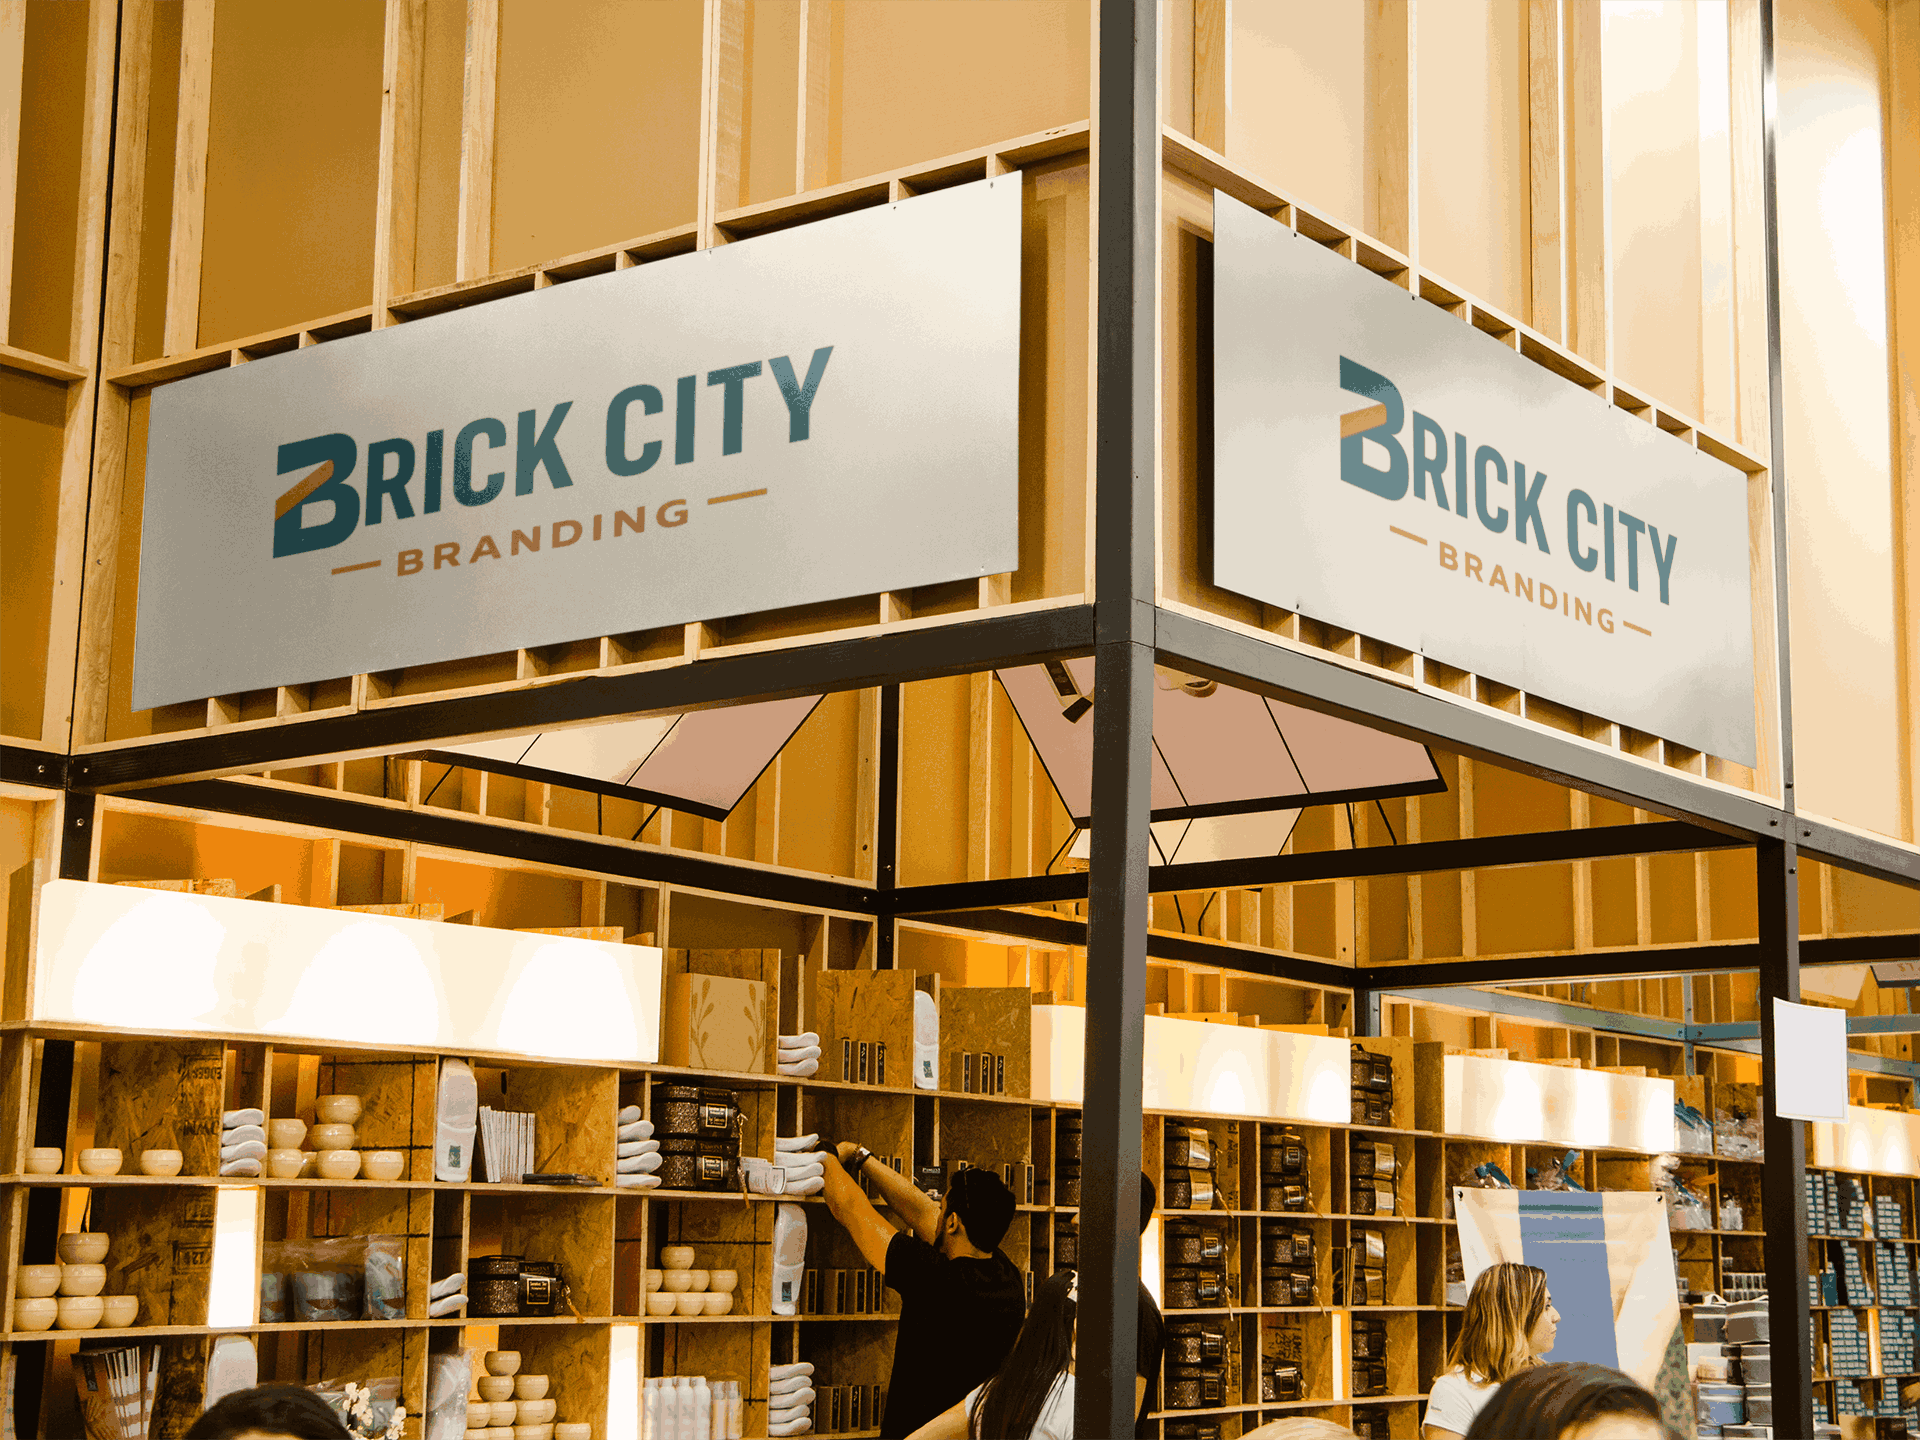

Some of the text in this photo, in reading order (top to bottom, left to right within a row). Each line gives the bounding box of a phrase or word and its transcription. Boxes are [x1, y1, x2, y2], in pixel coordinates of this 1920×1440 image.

[272, 346, 834, 559] BRICK CITY
[1339, 354, 1678, 605] BRICK CITY
[396, 498, 689, 578] BRANDING
[1439, 540, 1615, 634] BRANDING
